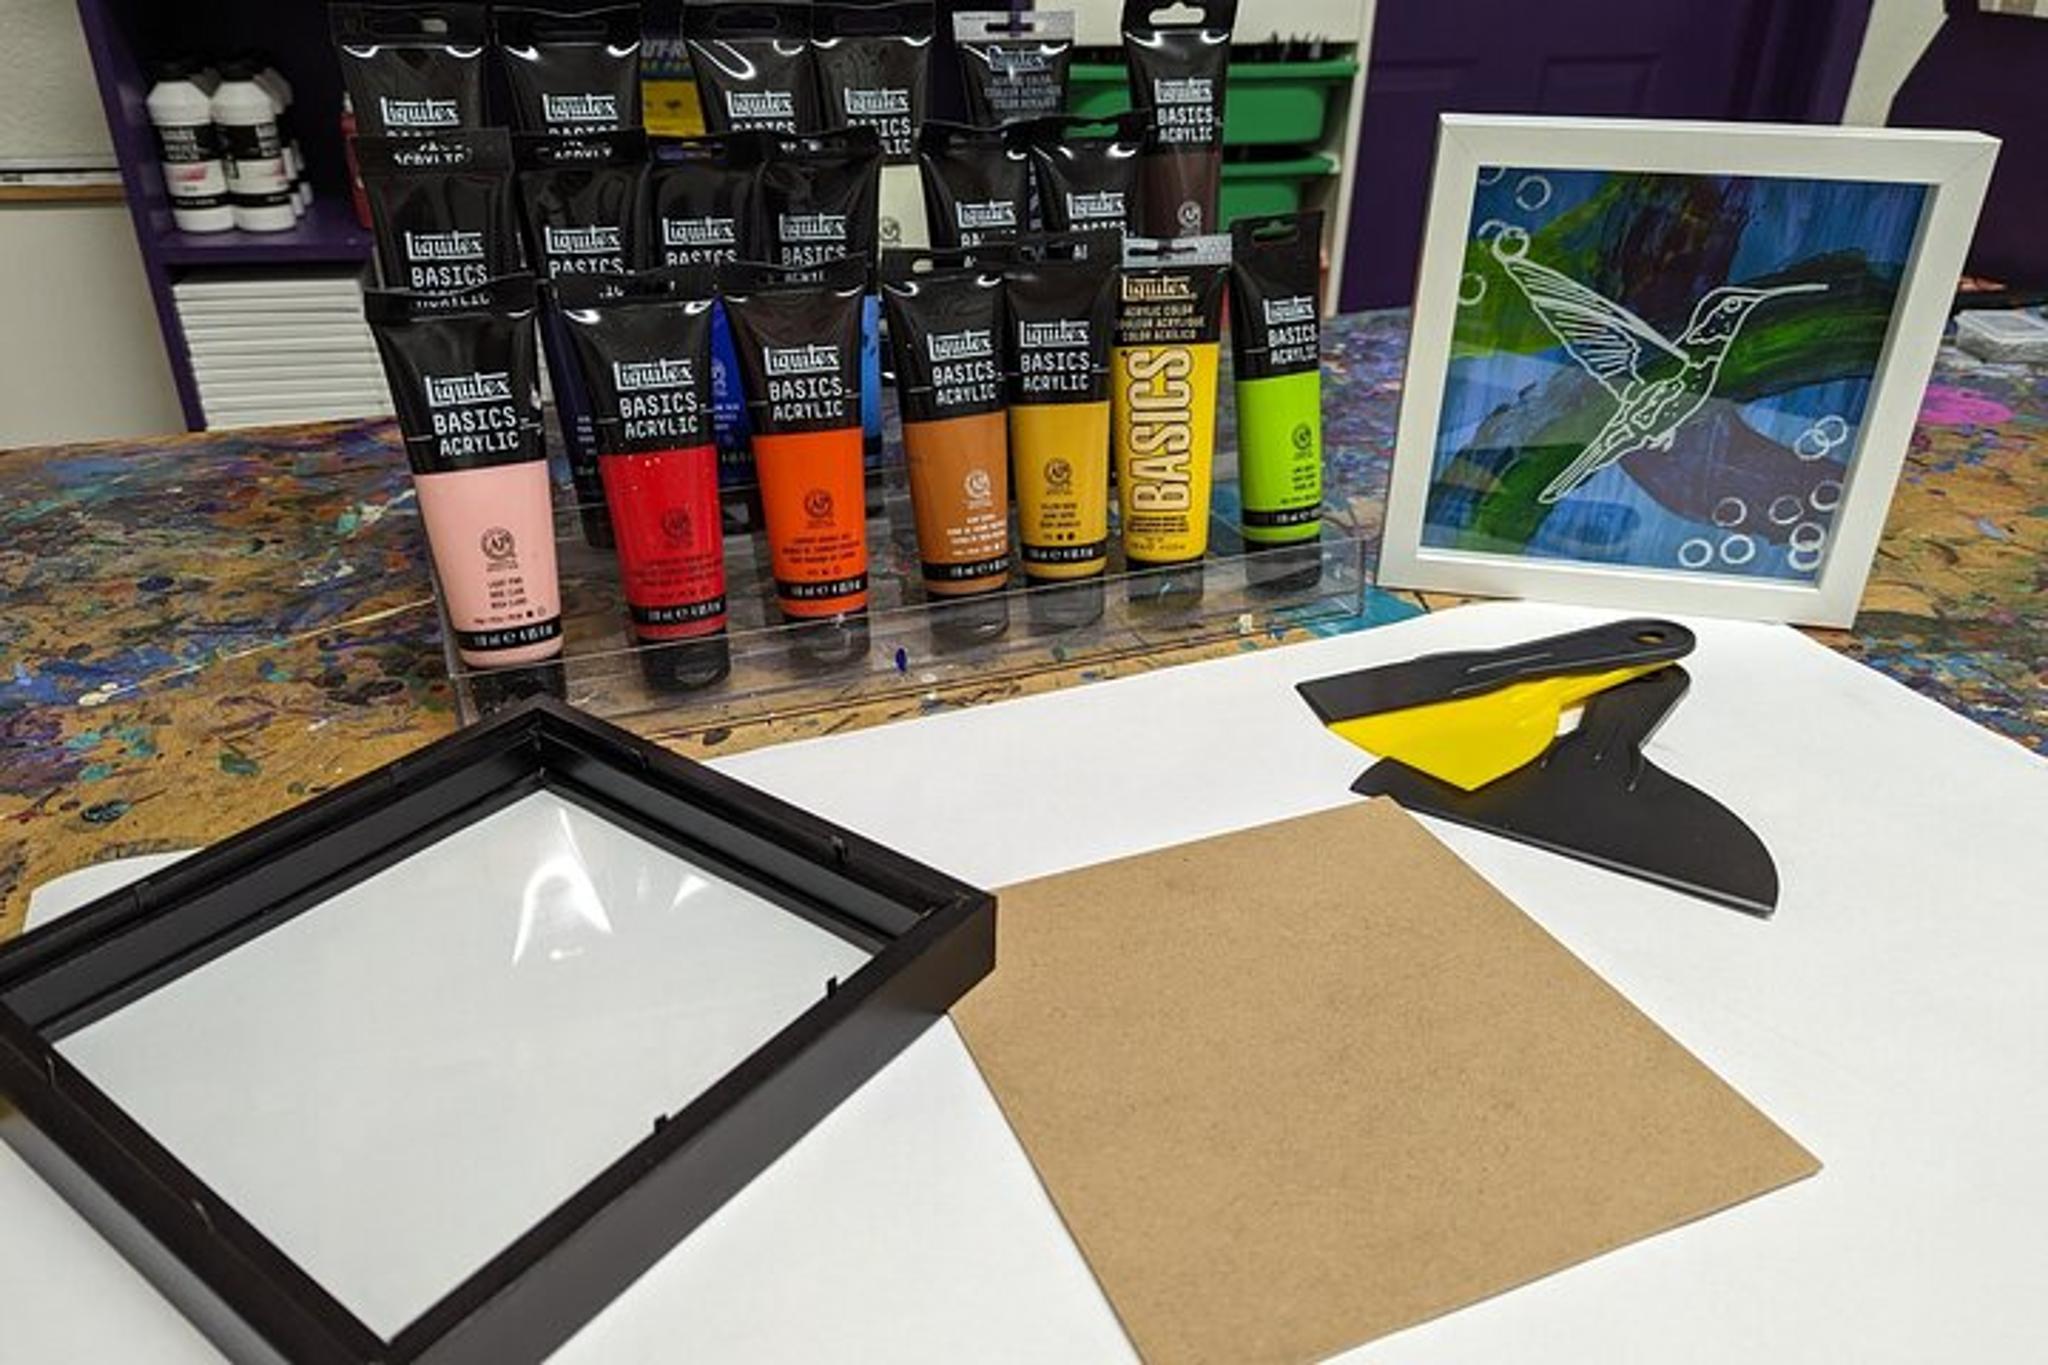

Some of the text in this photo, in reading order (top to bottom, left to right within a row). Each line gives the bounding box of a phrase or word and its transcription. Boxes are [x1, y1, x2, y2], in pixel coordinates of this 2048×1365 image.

[380, 96, 461, 126] Liquitex
[542, 93, 618, 122] Liquitex
[725, 89, 794, 118] Liquitex
[1157, 106, 1213, 126] BASICS
[1159, 126, 1213, 143] ACRYLIC
[545, 225, 621, 253] Liquitex
[662, 216, 736, 245] Liquitex
[779, 212, 846, 241] Liquitex
[405, 230, 484, 260] Liquitex
[412, 264, 487, 288] BASICS
[1122, 275, 1191, 301] Liquitex
[927, 329, 994, 361] Liquitex
[1019, 319, 1090, 347] Liquitex
[1268, 324, 1317, 348] BASICS
[613, 358, 695, 391] Liquitex
[763, 345, 840, 376] Liquitex
[932, 361, 995, 387] BASICS
[1020, 352, 1090, 373] BASICS
[424, 372, 512, 407] Liquitex
[768, 376, 842, 402] BASICS
[935, 383, 996, 407] ACRYLIC
[1023, 374, 1089, 392] ACRYLIC
[619, 391, 697, 419] BASICS
[773, 400, 843, 421] ACRYLIC
[433, 406, 516, 436] BASICS
[625, 415, 698, 440] ACRYLIC
[1128, 346, 1192, 513] BASICS
[440, 430, 519, 456] ACRYLIC
